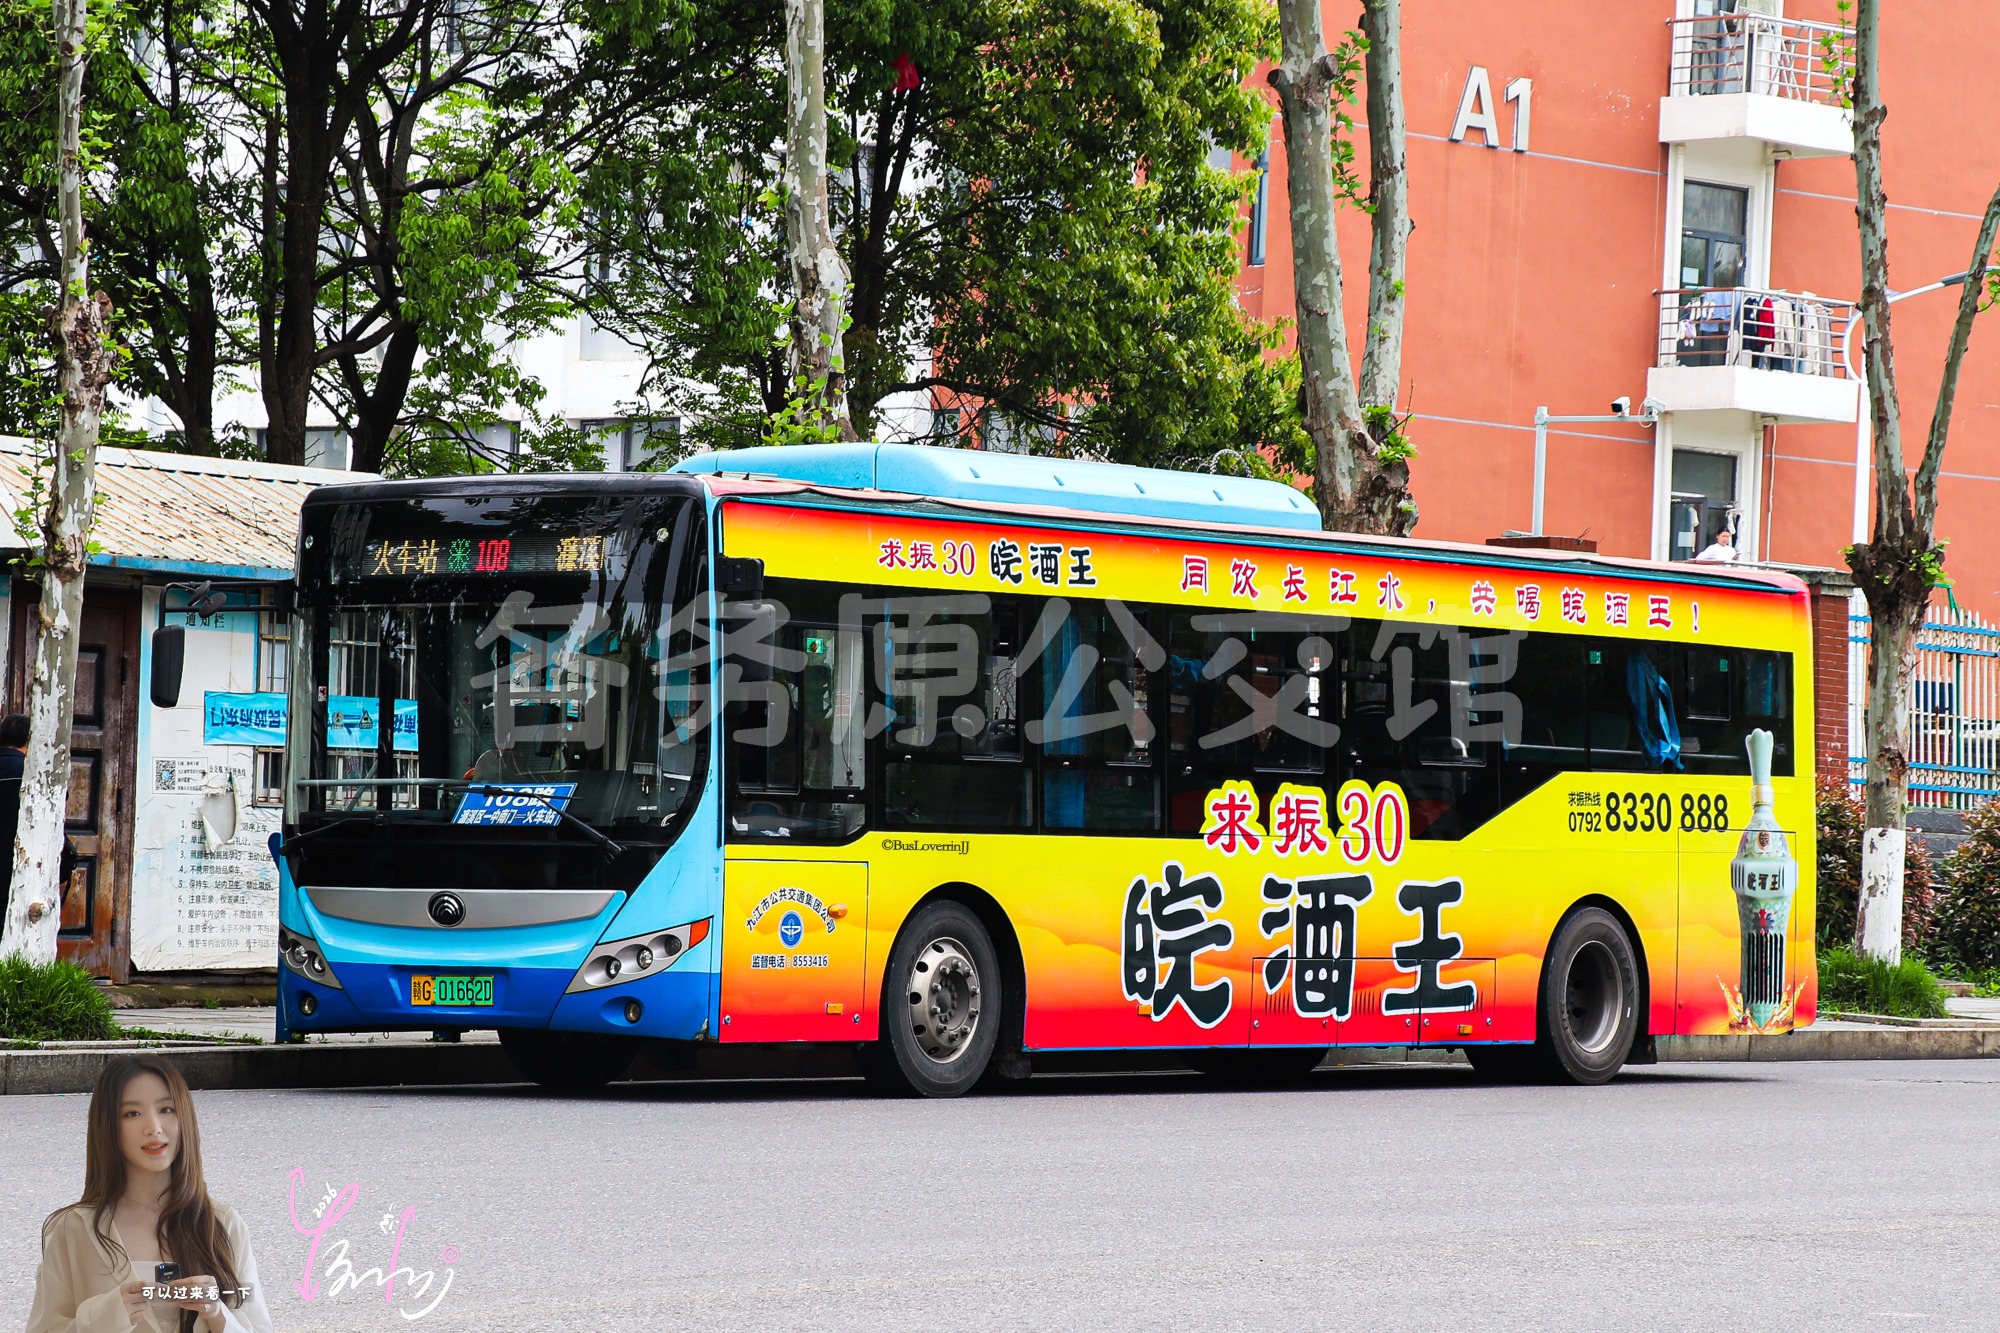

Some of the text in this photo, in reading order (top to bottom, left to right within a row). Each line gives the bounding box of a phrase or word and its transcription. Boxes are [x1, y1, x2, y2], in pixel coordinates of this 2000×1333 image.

[1448, 65, 1532, 152] A1
[370, 539, 440, 576] 火车站
[474, 539, 511, 572] 108
[879, 538, 1098, 586] 求振30 皖酒王
[1568, 791, 1601, 807] 求振热线
[1568, 792, 1729, 833] 0792 8330 888
[1207, 791, 1402, 862] 求振30
[747, 887, 836, 934] 九江市公共交通集团公司
[1123, 862, 1477, 1028] 皖酒王
